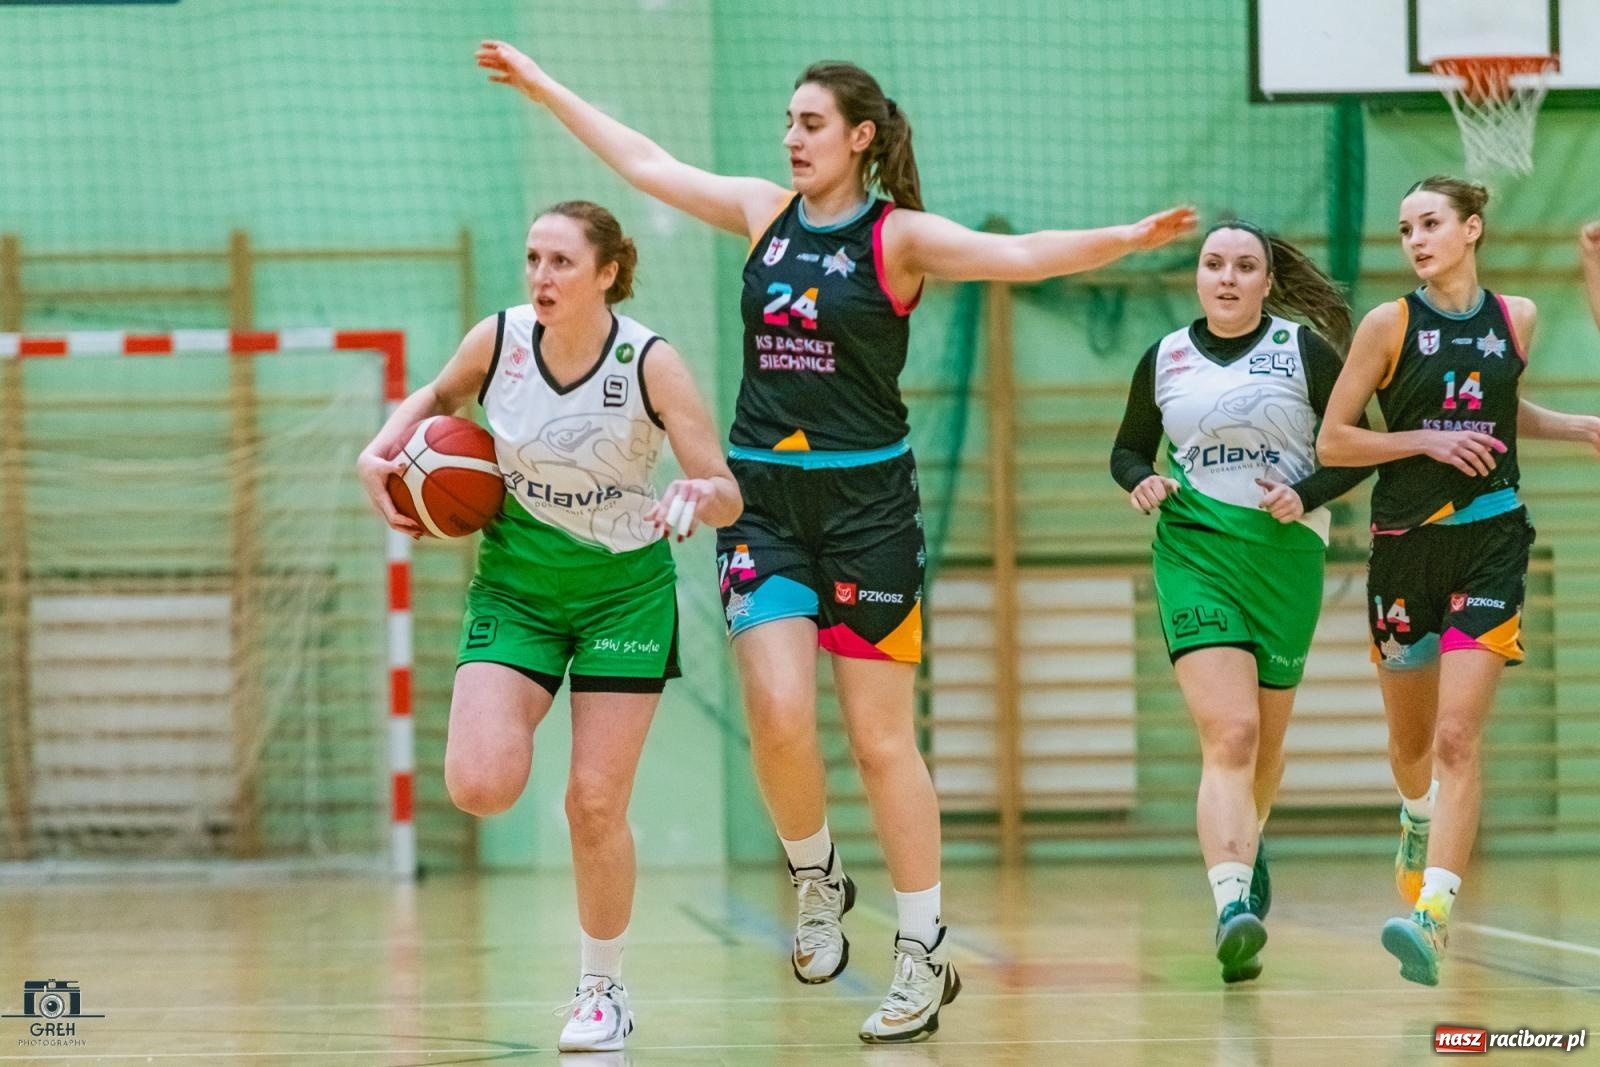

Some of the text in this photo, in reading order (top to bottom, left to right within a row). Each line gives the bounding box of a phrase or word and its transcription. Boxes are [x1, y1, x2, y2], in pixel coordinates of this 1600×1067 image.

[763, 281, 819, 331] 24
[755, 335, 834, 355] KS BASKET
[759, 354, 836, 373] SIECHNICE
[1249, 353, 1296, 377] 24
[603, 374, 628, 407] 9
[1442, 371, 1484, 410] 14
[1422, 419, 1496, 434] KS BASKET
[1202, 444, 1280, 467] Clavis
[527, 480, 622, 508] Clavis
[717, 543, 757, 594] 24
[858, 590, 904, 604] PZKosz
[1466, 596, 1506, 610] PZKosz
[1172, 605, 1228, 639] 24
[1374, 595, 1411, 633] 14
[466, 615, 498, 649] 9
